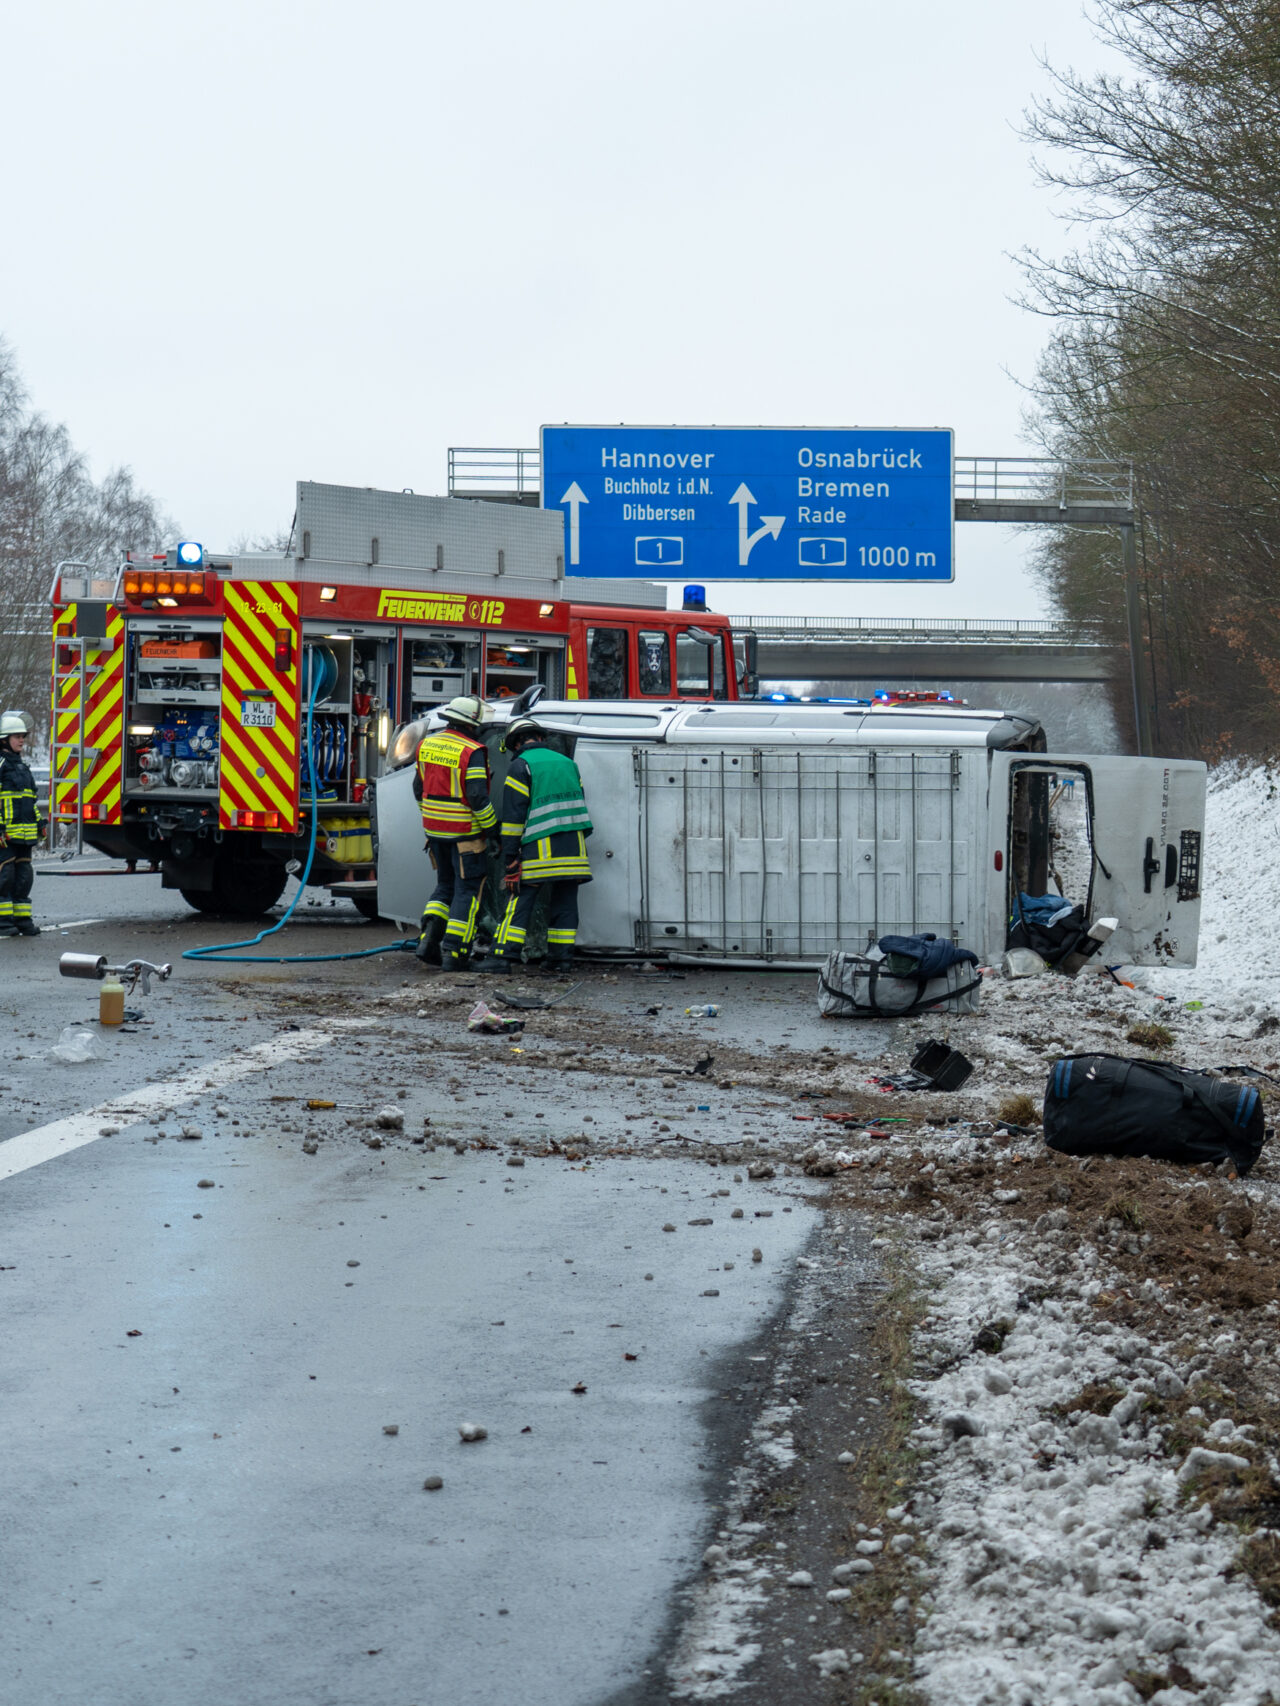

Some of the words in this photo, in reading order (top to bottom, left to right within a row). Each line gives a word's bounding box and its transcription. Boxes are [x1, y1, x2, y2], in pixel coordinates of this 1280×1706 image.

[601, 447, 715, 469] Hannover
[798, 447, 923, 469] Osnabrück
[604, 477, 670, 495] Buchholz
[678, 478, 714, 495] i.d.N.
[798, 477, 890, 498] Bremen
[623, 503, 696, 521] Dibbersen
[798, 506, 847, 524] Rade
[656, 542, 663, 560] 1
[819, 543, 826, 561] 1
[858, 546, 909, 567] 1000
[915, 552, 936, 567] m
[377, 589, 467, 623] FEUERWEHR
[480, 600, 505, 625] 112
[252, 703, 265, 714] WL
[243, 714, 250, 725] R
[250, 714, 273, 726] 3110
